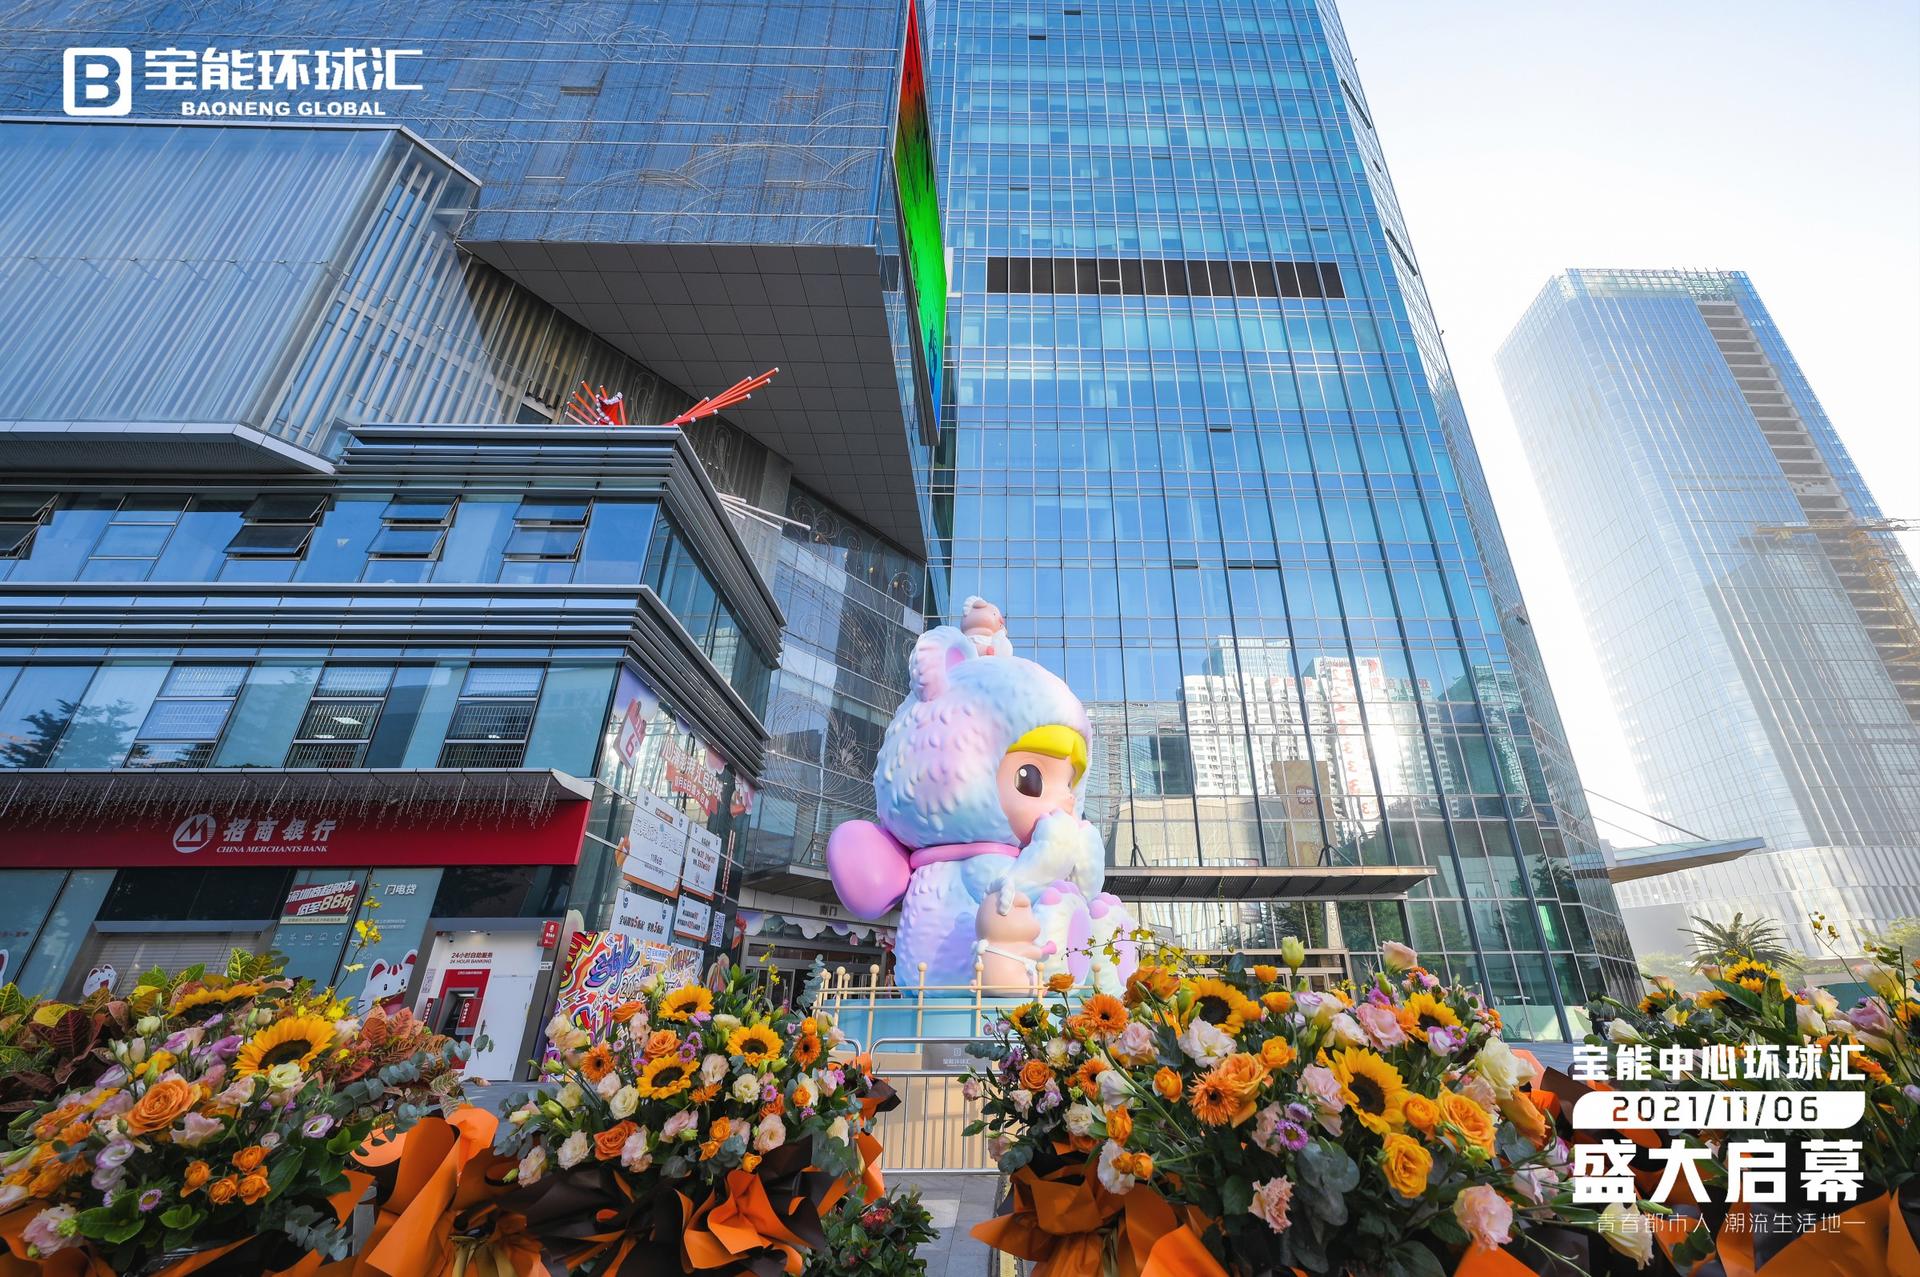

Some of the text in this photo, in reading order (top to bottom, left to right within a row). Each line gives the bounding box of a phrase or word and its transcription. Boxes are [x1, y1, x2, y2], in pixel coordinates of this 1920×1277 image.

[216, 845, 328, 853] CHINA MERCHANTS BANK
